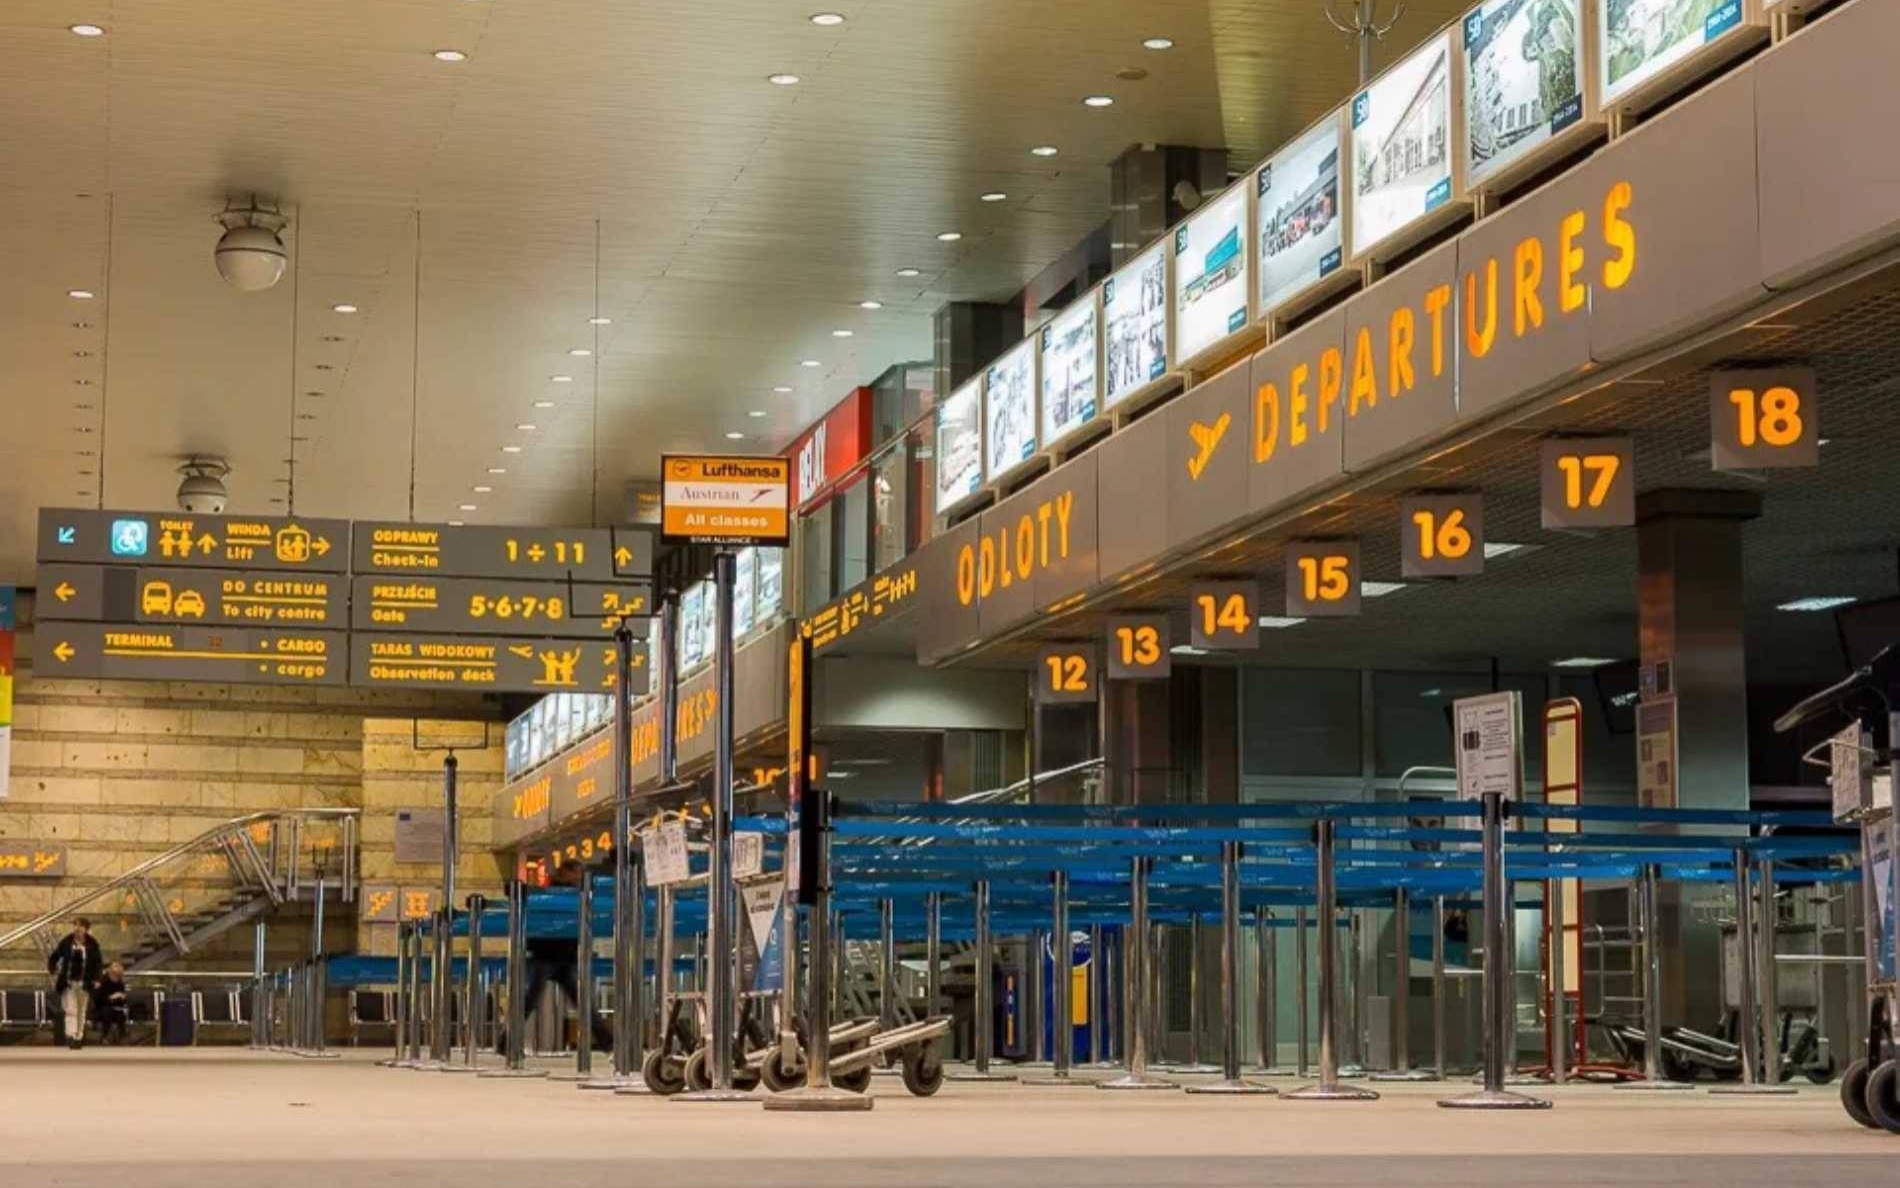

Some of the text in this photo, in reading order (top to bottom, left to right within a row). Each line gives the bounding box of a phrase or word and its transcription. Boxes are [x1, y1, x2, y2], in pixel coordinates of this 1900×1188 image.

[1254, 181, 1636, 464] DEPARTURES
[1729, 386, 1802, 446] 18
[702, 463, 780, 478] Lufthansa
[1557, 455, 1619, 508] 17
[681, 486, 739, 500] Austrian
[685, 513, 768, 527] All classes
[227, 523, 271, 536] WINDA
[373, 530, 439, 544] ODPRAWY
[1413, 509, 1471, 559] 16
[226, 546, 253, 560] Lift
[506, 540, 518, 562] 1
[554, 541, 584, 564] 11
[957, 490, 1073, 606] ODLOTY
[372, 553, 439, 567] Check-in
[1298, 556, 1349, 601] 15
[223, 580, 328, 596] DO CENTRUM
[222, 603, 326, 620] To city centre
[372, 609, 406, 623] Gate
[1198, 594, 1250, 635] 14
[105, 633, 174, 648] TERMINAL
[276, 639, 325, 653] CARGO
[1117, 626, 1160, 665] 13
[371, 643, 496, 658] TARAS WIDOKOWY
[276, 664, 326, 679] cargo
[369, 666, 496, 682] Observation deck
[1046, 655, 1087, 691] 12
